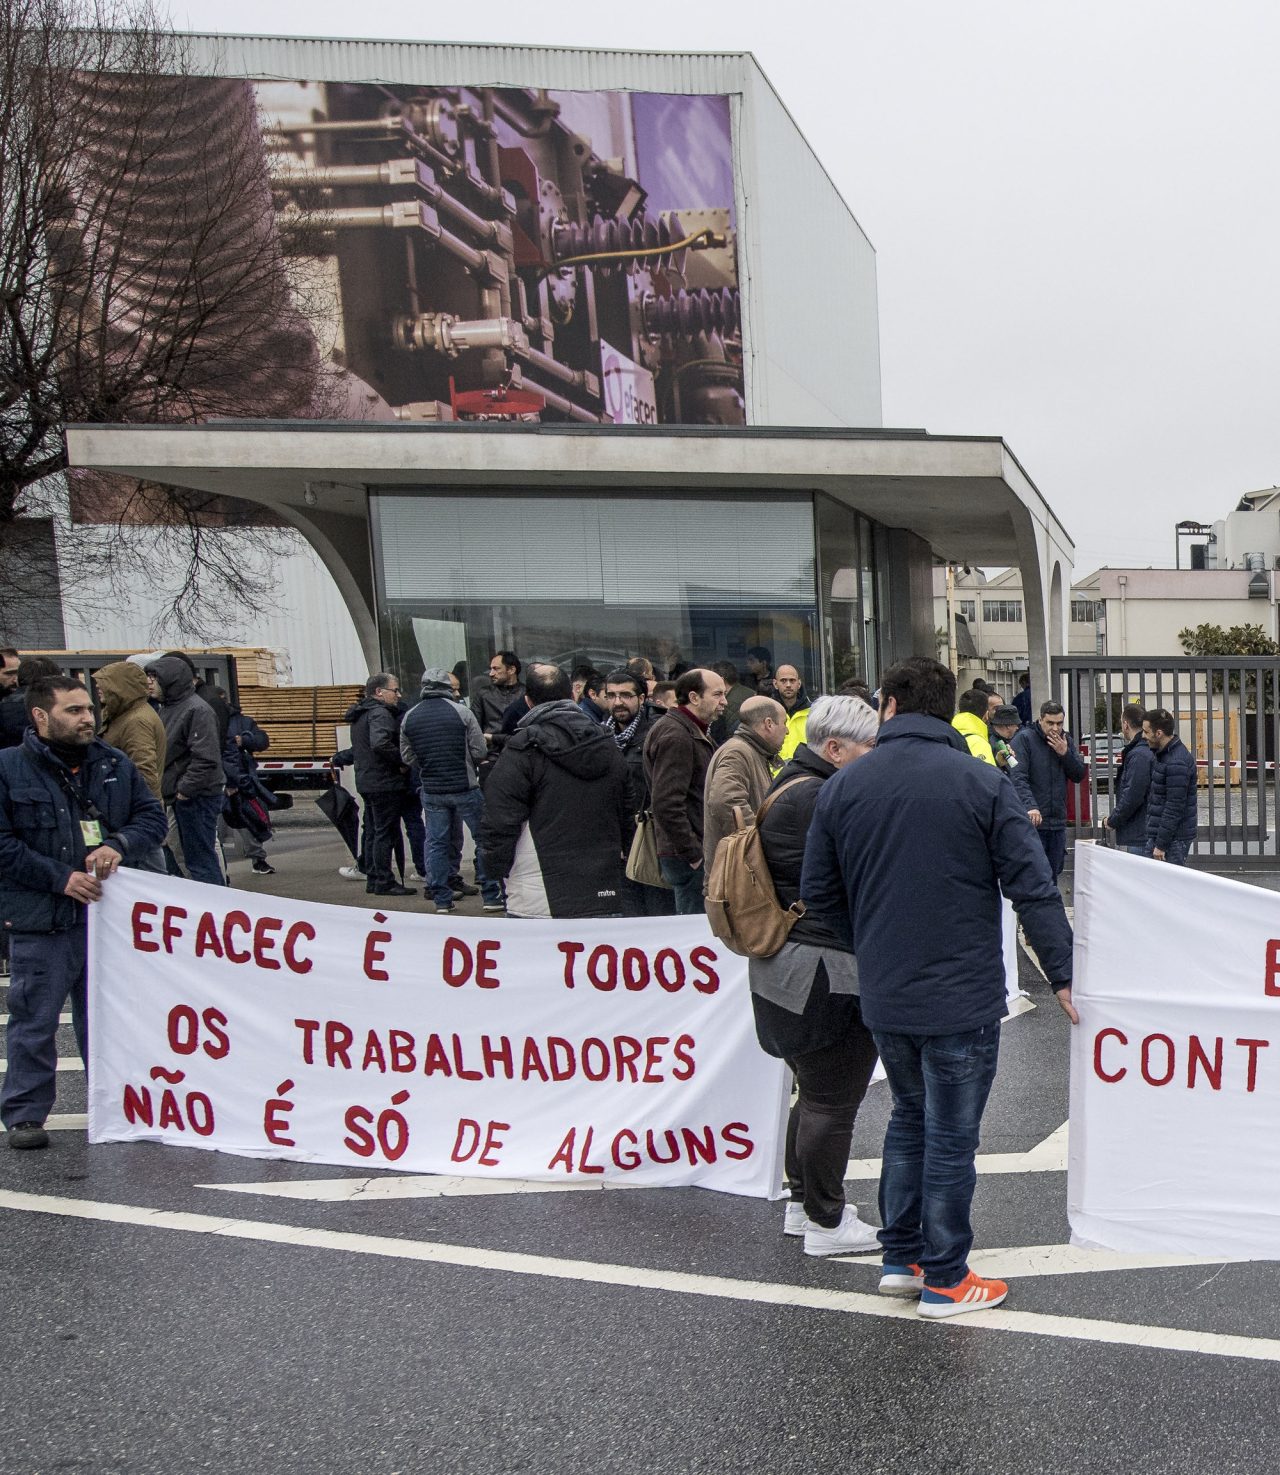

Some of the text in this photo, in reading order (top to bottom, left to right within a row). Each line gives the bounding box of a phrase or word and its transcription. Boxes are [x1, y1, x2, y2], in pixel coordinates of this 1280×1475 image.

[132, 902, 314, 975] EFACEC
[443, 937, 501, 989] DE
[557, 941, 720, 995] TODOS
[168, 1005, 696, 1083] OS TRABALHADORES
[124, 1067, 754, 1175] NÃO É SÓ DE ALGUNS
